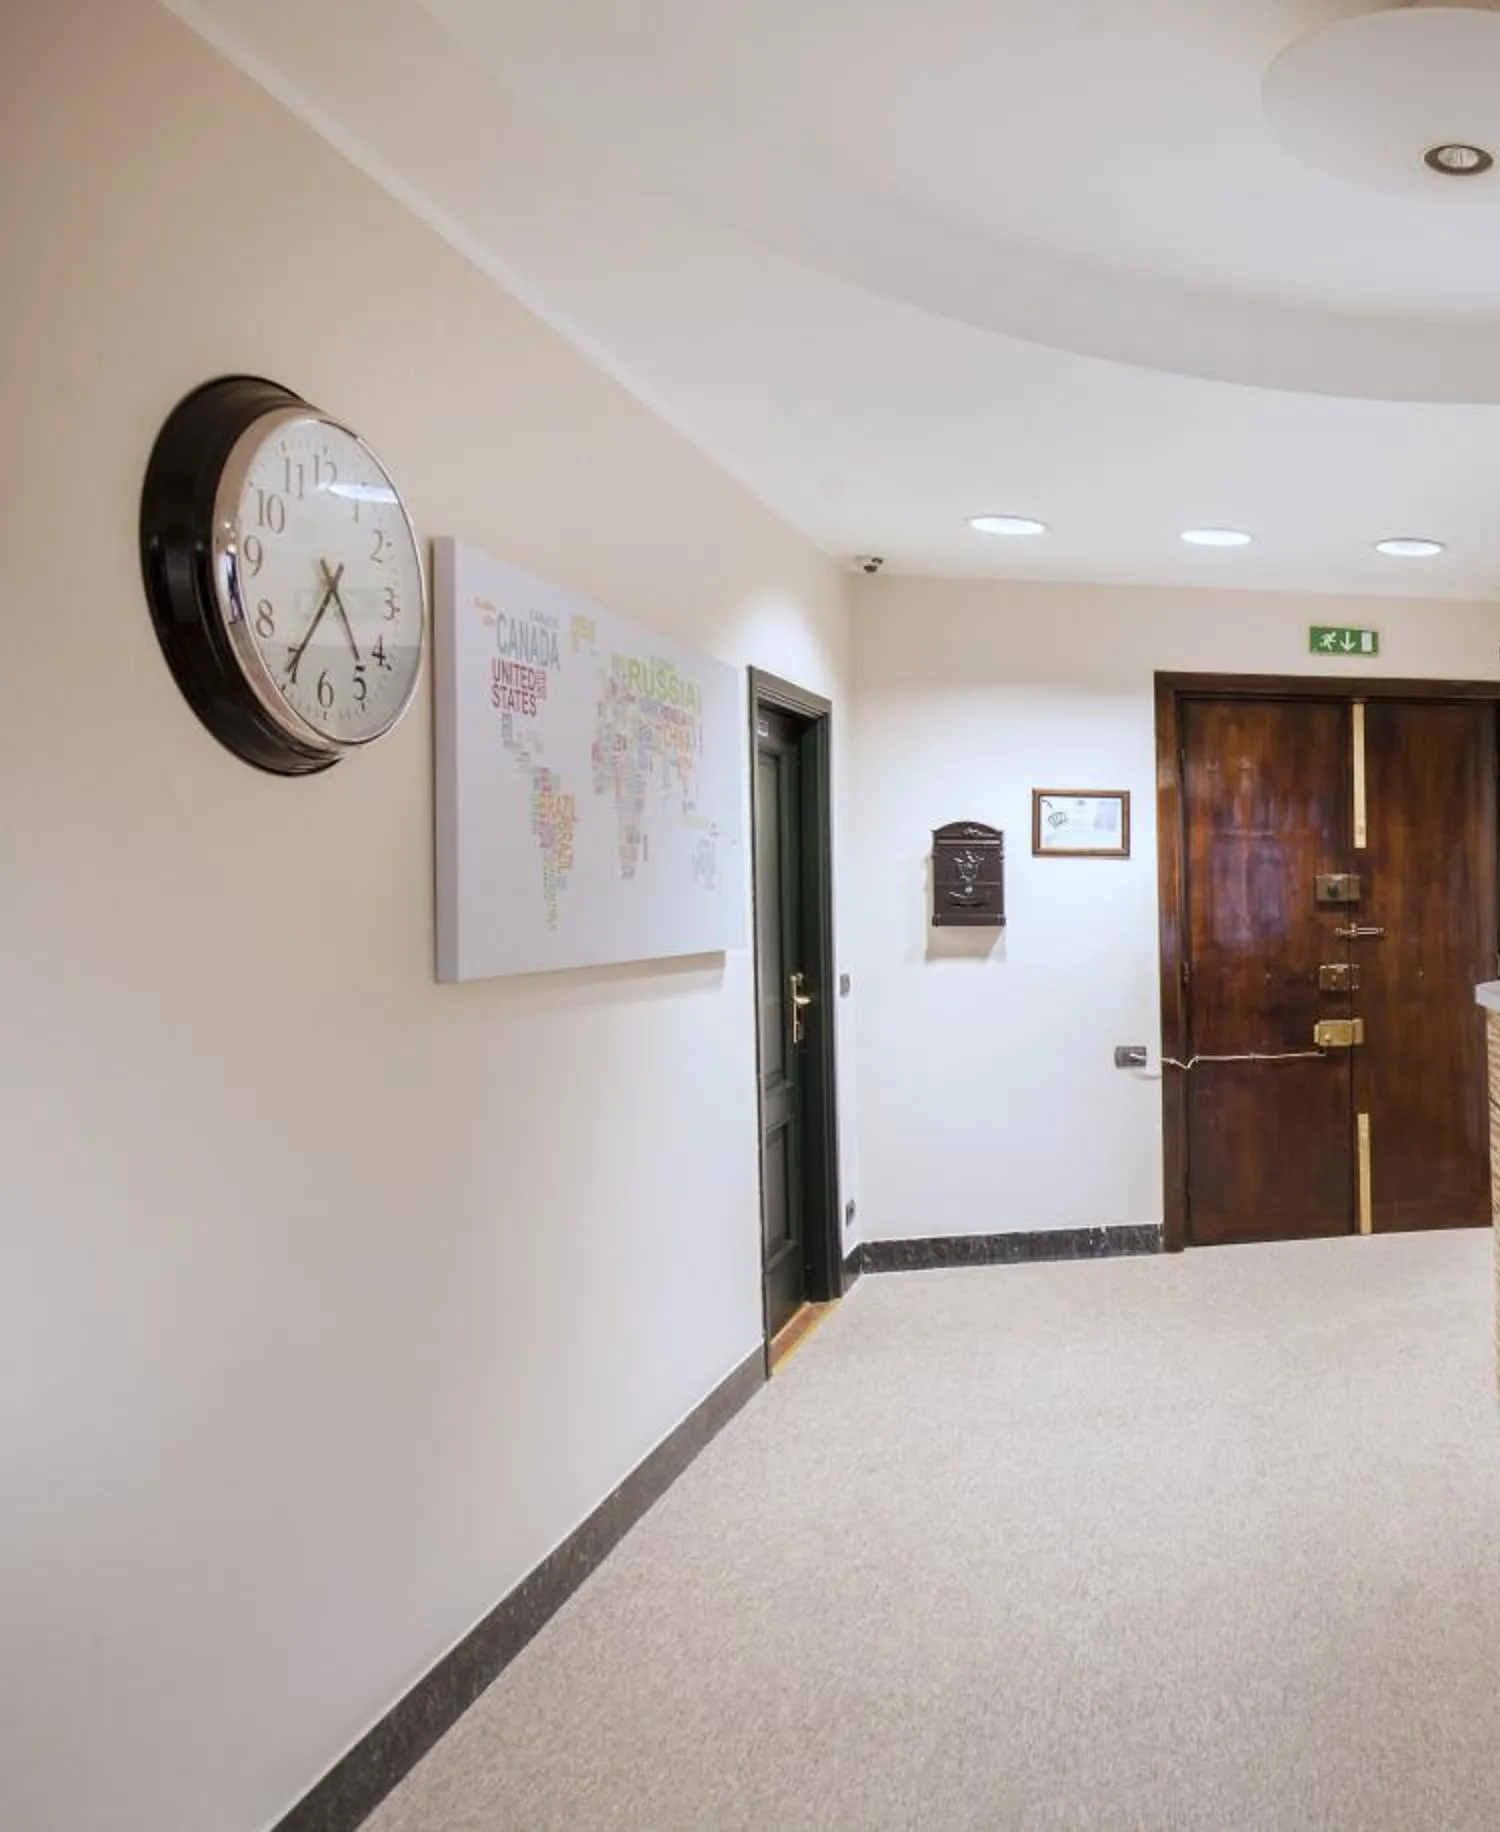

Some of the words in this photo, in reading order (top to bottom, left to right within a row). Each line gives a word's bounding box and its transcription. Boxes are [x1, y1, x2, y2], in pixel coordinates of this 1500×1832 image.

[282, 455, 306, 498] 11
[312, 453, 338, 490] 12
[256, 489, 285, 533] 10
[243, 534, 264, 577] 9
[369, 529, 386, 564] 2
[255, 598, 276, 639] 8
[383, 586, 399, 621] 3
[372, 634, 388, 668] 4
[496, 610, 561, 672] CANADA
[285, 646, 302, 684] 7
[352, 665, 369, 702] 5
[492, 656, 536, 691] UNITED
[626, 657, 698, 708] RUSSIA
[317, 671, 335, 708] 6
[491, 682, 537, 718] STATES
